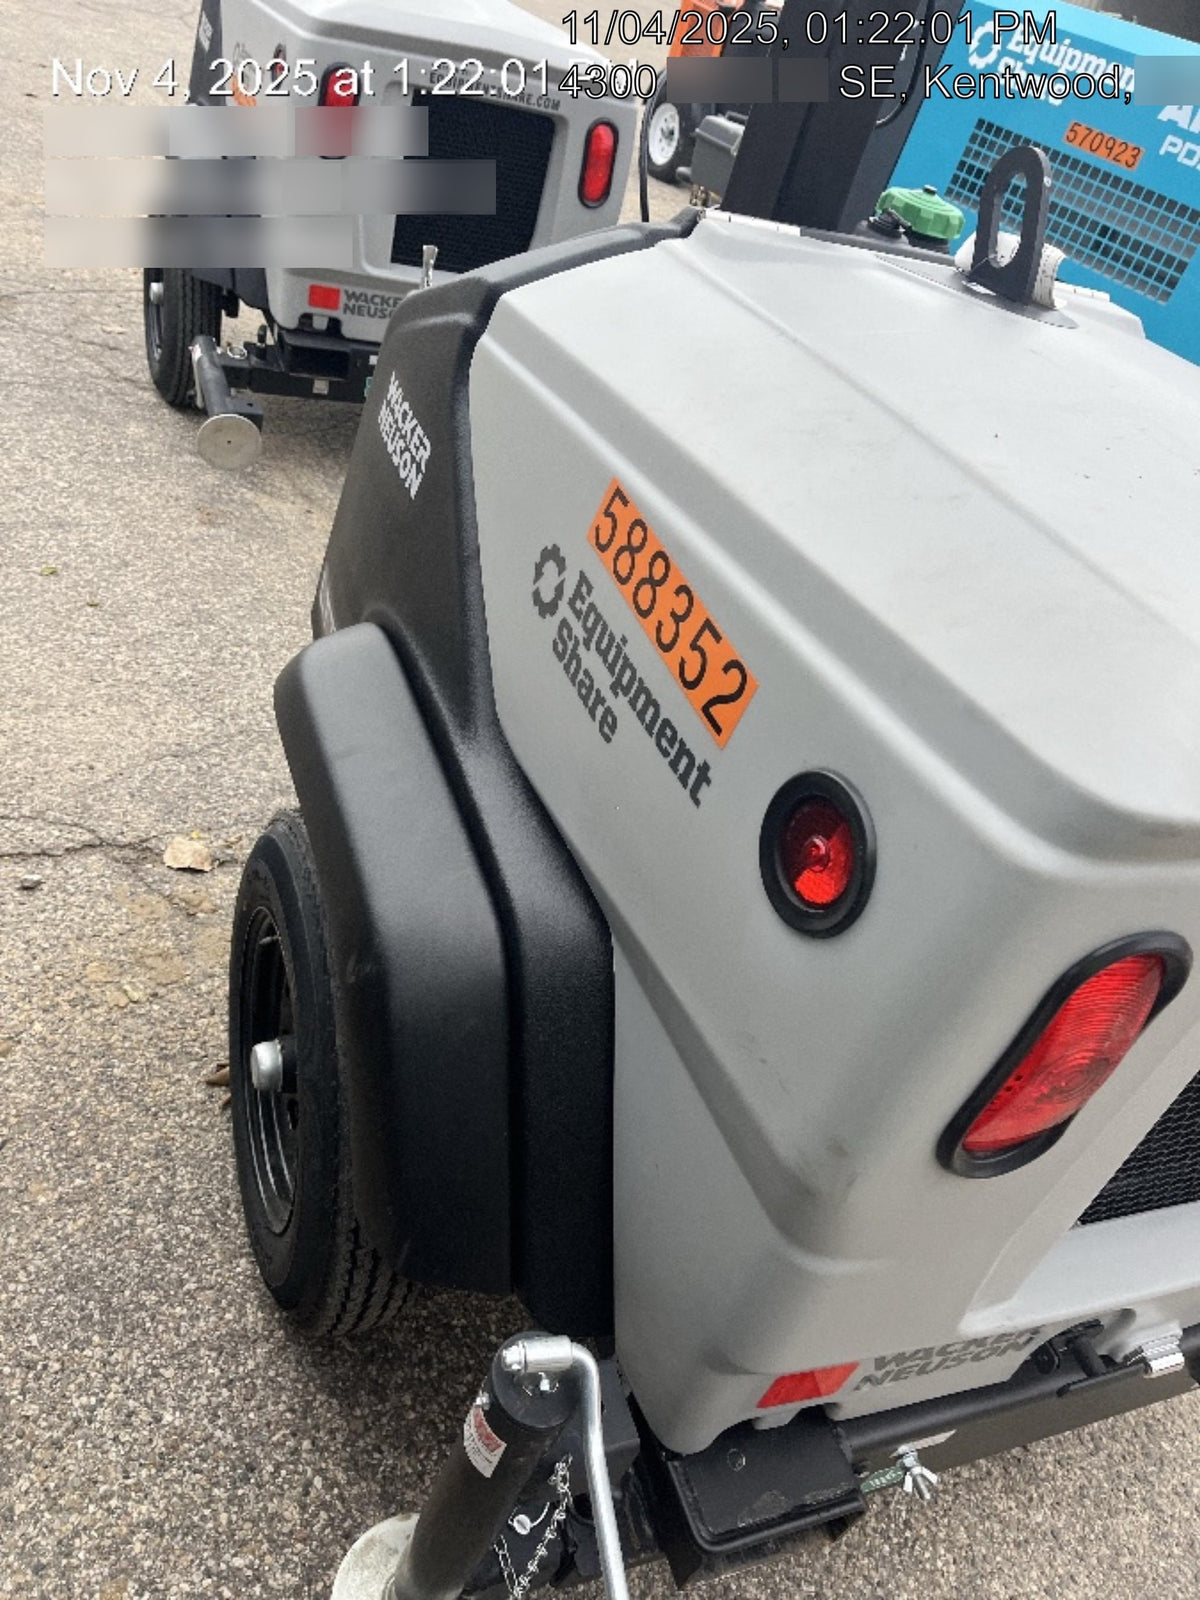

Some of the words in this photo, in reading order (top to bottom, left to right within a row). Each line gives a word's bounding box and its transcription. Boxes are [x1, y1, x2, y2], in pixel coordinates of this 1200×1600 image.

[1006, 23, 1134, 92] Equipmen
[1066, 121, 1141, 168] 570923
[1159, 134, 1200, 171] PO
[342, 303, 393, 320] NEUS
[343, 289, 403, 309] WACKE
[378, 399, 424, 501] NEUSON
[387, 370, 432, 474] WACKER
[594, 485, 748, 737] 588352
[552, 616, 619, 745] Share
[567, 569, 712, 809] Equipment
[853, 1337, 1036, 1392] NEUSON
[874, 1324, 1046, 1371] WACKER
